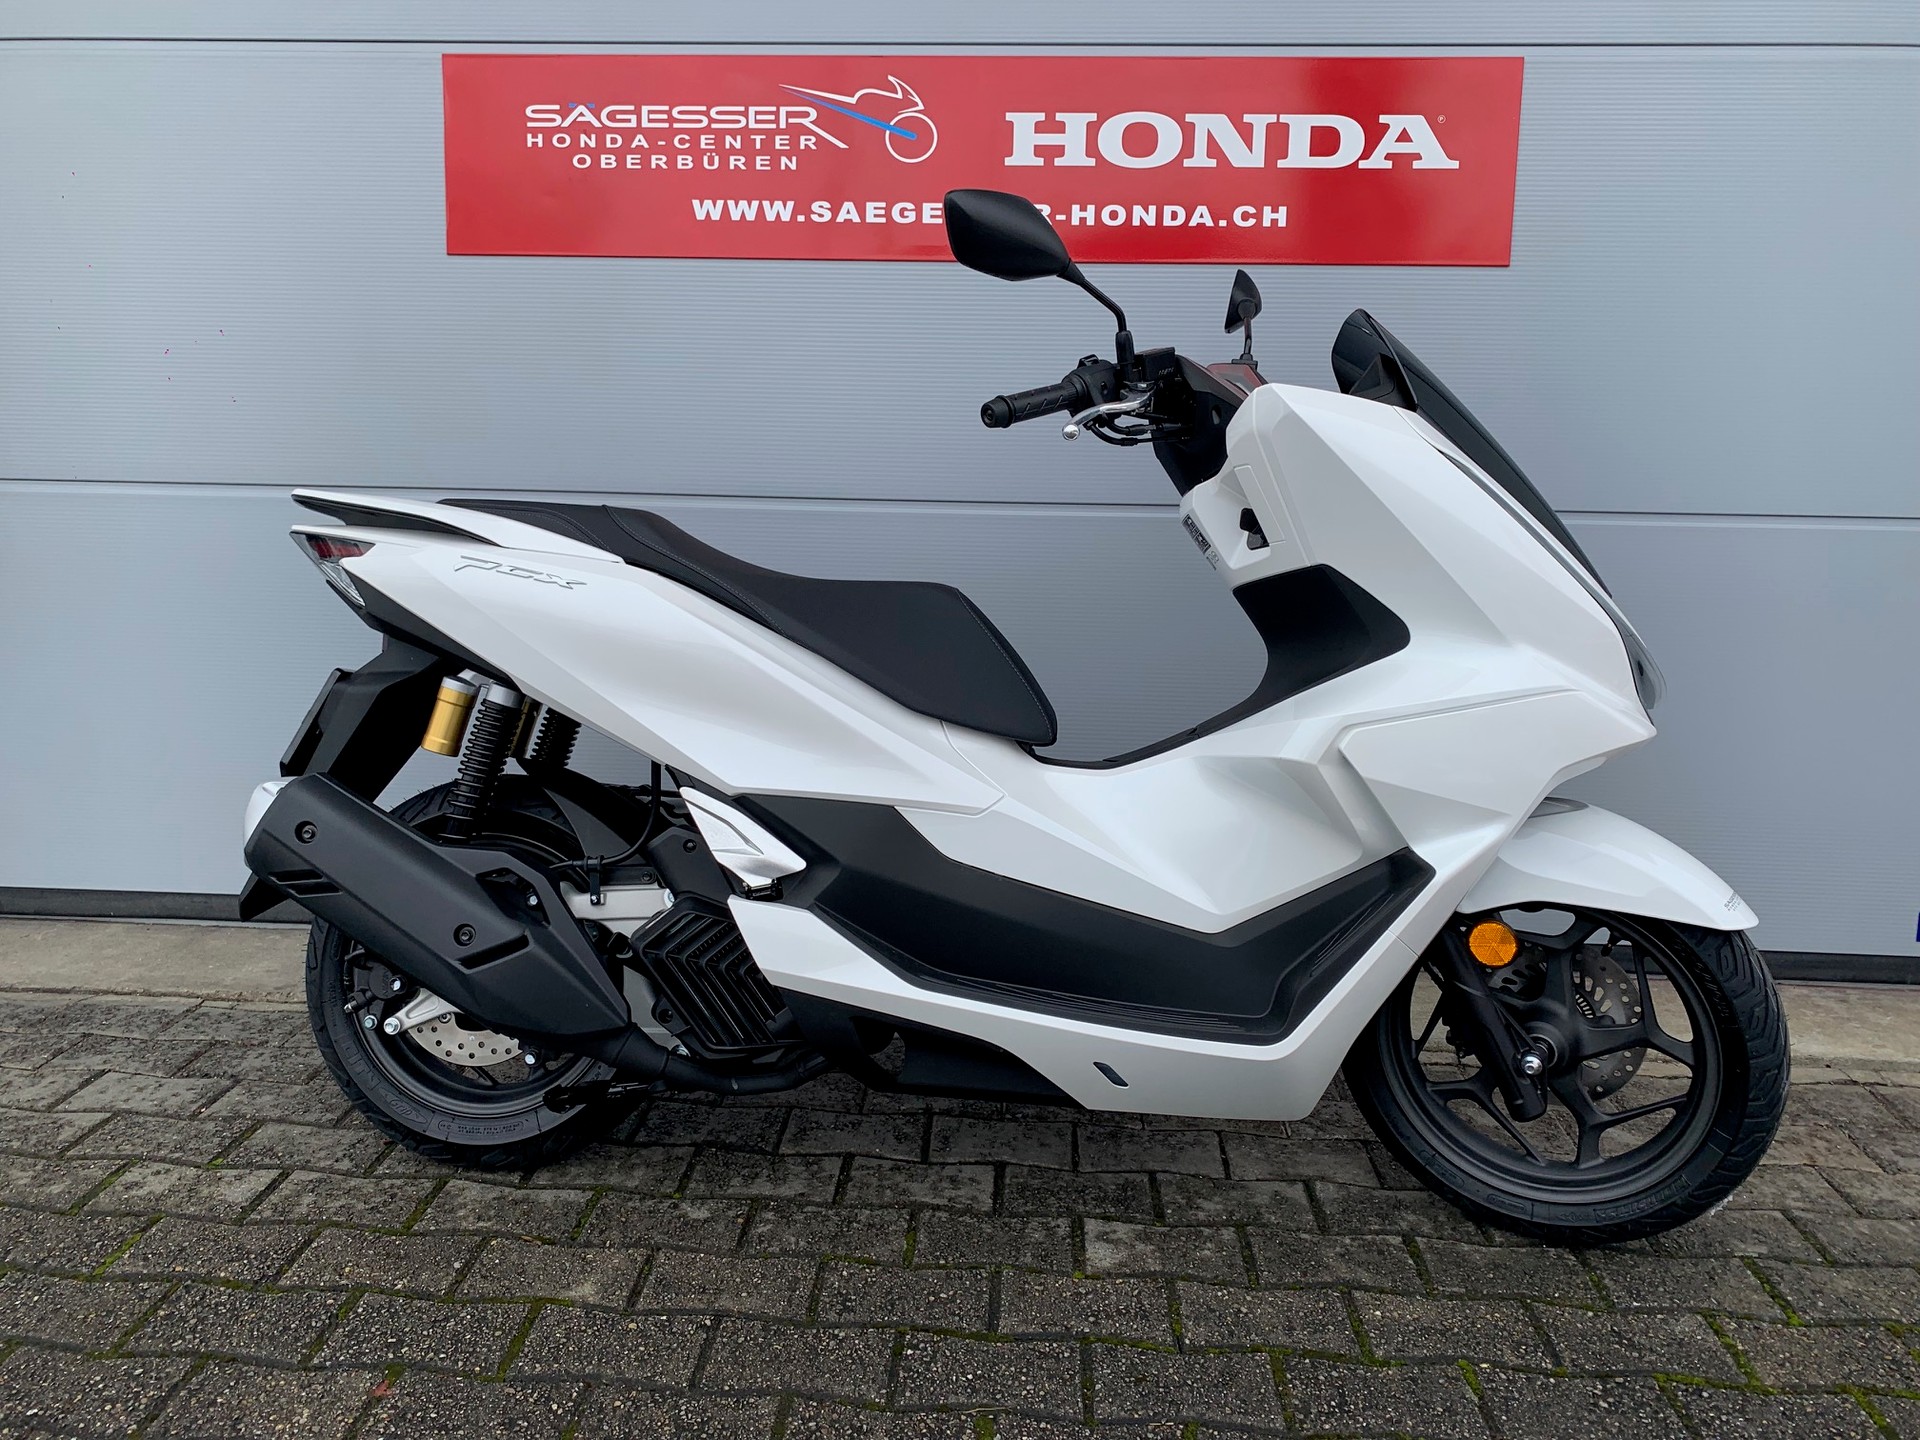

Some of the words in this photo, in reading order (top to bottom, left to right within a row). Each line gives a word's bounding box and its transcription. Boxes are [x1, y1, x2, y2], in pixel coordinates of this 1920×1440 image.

[526, 132, 818, 150] HONDA-CENTER
[1004, 111, 1460, 169] HONDA
[572, 153, 798, 171] OBERBÜREN
[691, 199, 1287, 228] WWW.SAEGE-HONDA.CH
